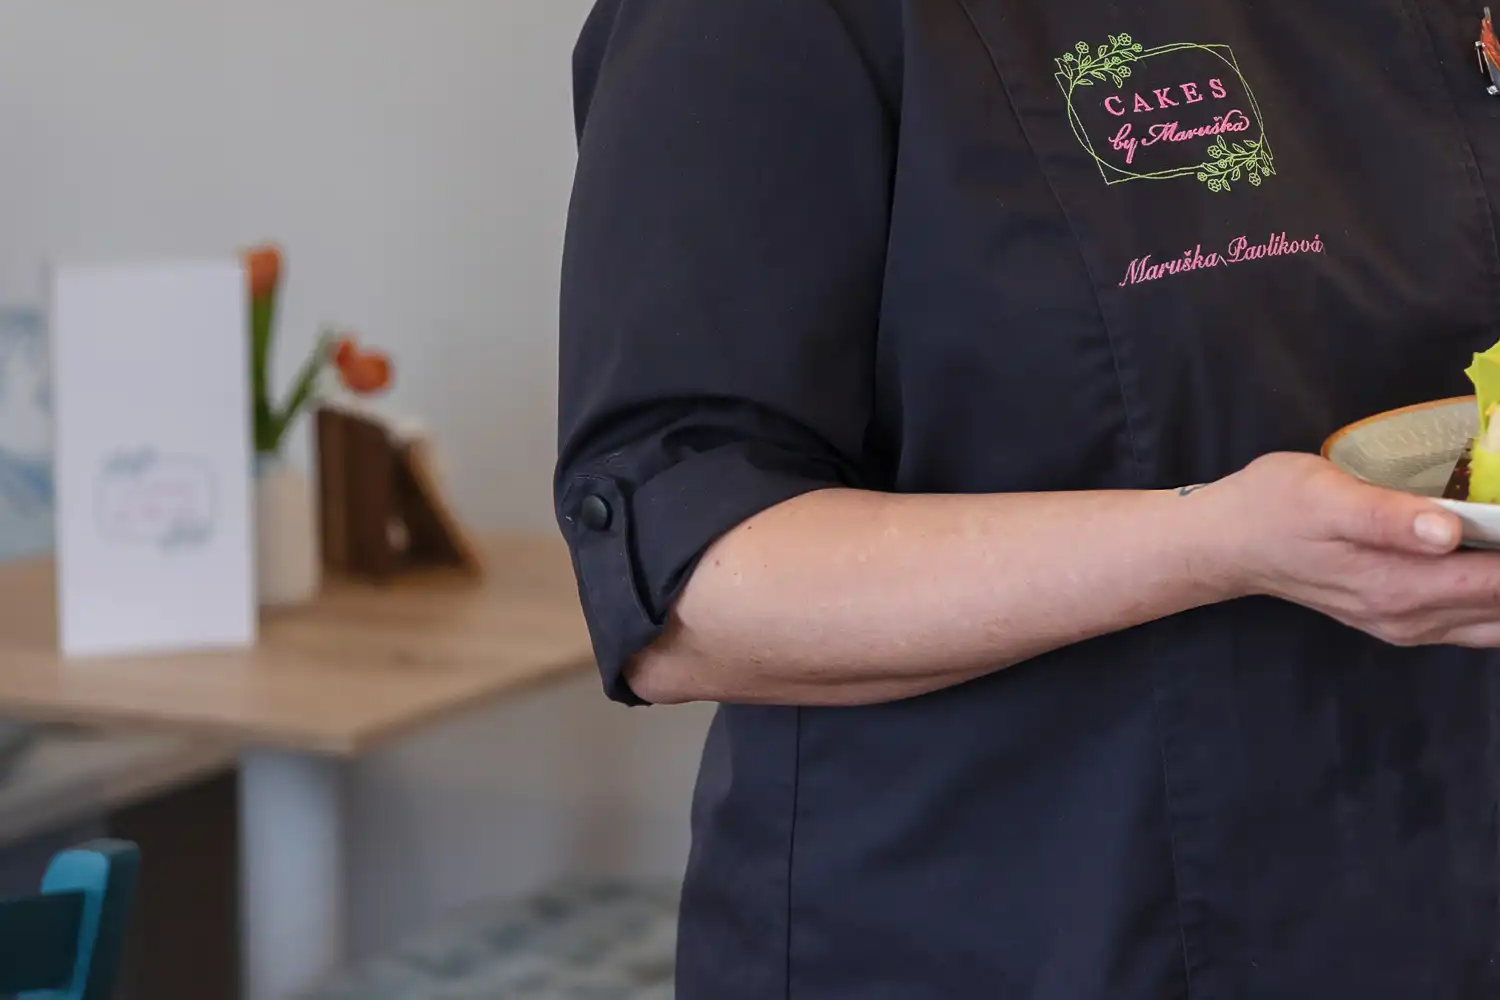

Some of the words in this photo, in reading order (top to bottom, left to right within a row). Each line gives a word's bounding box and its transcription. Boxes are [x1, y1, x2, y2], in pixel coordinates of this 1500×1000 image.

[1104, 78, 1228, 116] CAKES
[1108, 123, 1139, 164] by
[1142, 110, 1250, 146] Maruška
[1119, 244, 1220, 287] Maruška
[1227, 231, 1323, 263] Pavlíková
